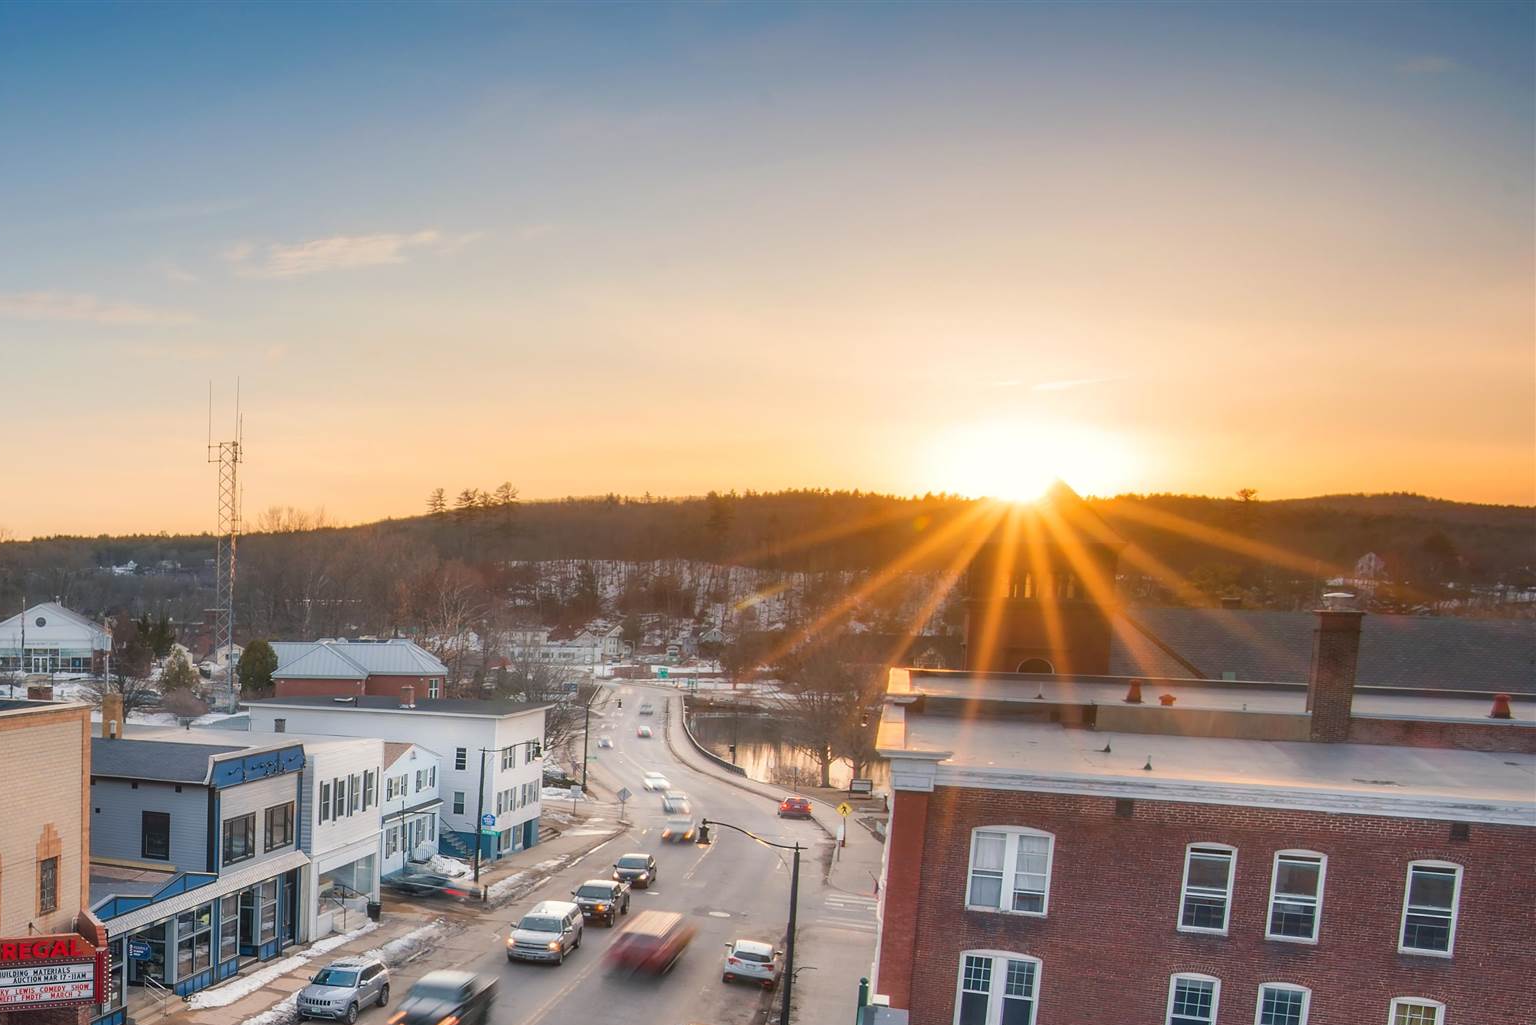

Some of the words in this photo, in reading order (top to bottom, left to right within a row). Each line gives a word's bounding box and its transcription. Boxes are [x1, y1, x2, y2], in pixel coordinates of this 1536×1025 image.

[1, 939, 81, 961] REGAL
[32, 966, 71, 976] MATERIALS
[13, 974, 42, 984] AUCTION
[43, 972, 58, 981] MAR
[15, 986, 36, 995] LEWIS
[39, 984, 66, 994] COMEDY
[71, 982, 90, 991] SHOW
[50, 990, 73, 1000] MARCH
